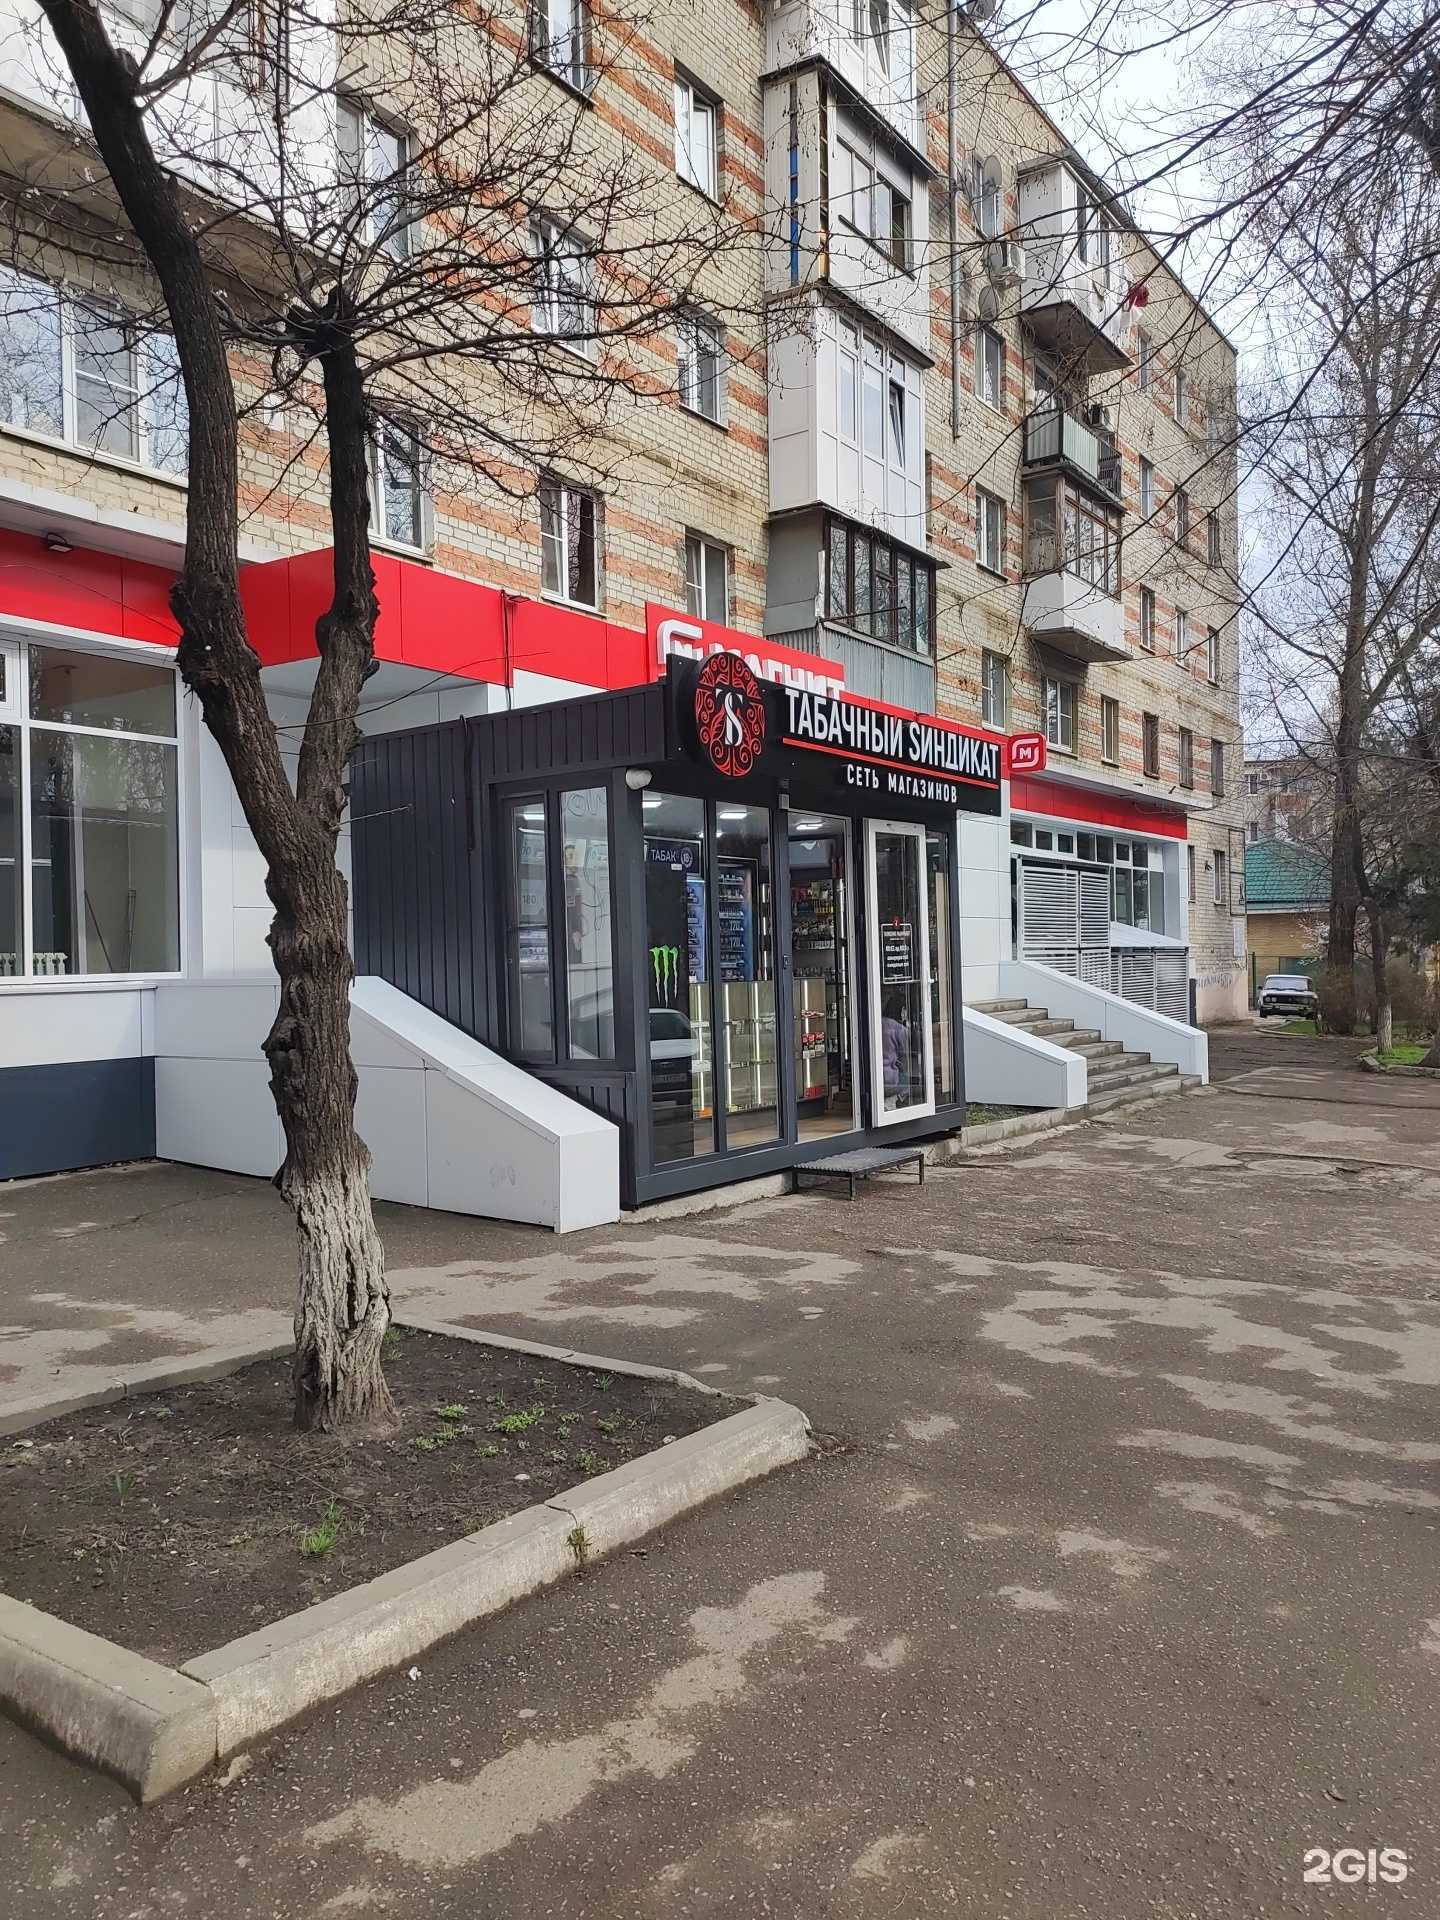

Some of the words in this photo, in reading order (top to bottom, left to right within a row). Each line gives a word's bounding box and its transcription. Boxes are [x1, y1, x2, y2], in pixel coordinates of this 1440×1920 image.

[908, 721, 999, 780] SИНДИКАТ
[847, 764, 879, 789] СЕТЬ
[888, 773, 958, 803] МАГАЗИНОВ
[651, 849, 676, 862] ТАБАК
